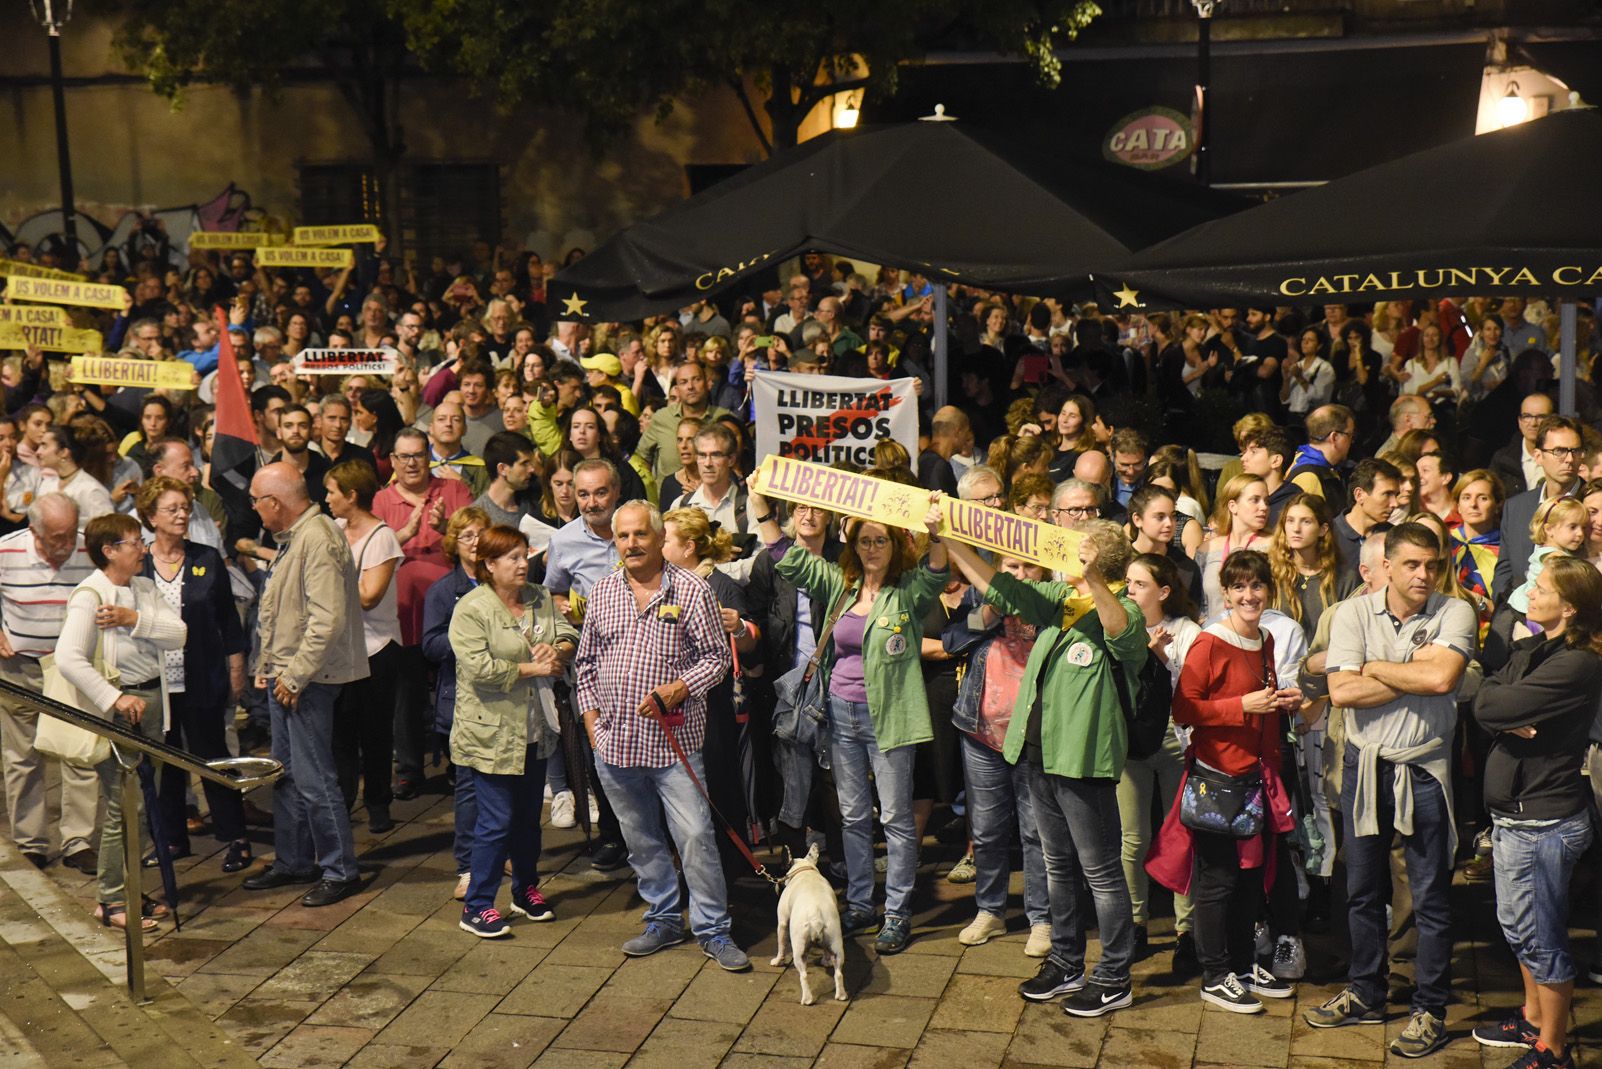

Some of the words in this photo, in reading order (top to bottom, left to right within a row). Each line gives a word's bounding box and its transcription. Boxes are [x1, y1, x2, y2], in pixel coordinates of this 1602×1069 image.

[1109, 128, 1187, 152] CATA
[279, 251, 308, 262] VOLEM
[319, 251, 344, 263] CASA!
[15, 279, 30, 295] US
[32, 281, 71, 298] VOLEM
[72, 286, 80, 299] A
[83, 287, 117, 301] CASA!
[1279, 266, 1541, 297] CATALUNYA
[15, 309, 22, 321] A
[26, 310, 60, 323] CASA!
[304, 351, 385, 363] LLIBERTAT
[82, 359, 158, 382] LLIBERTAT!
[777, 389, 893, 411] LLIBERTAT
[777, 413, 891, 440] PRESOS
[768, 459, 880, 511] LLIBERTAT!
[950, 502, 1039, 556] LLIBERTAT!
